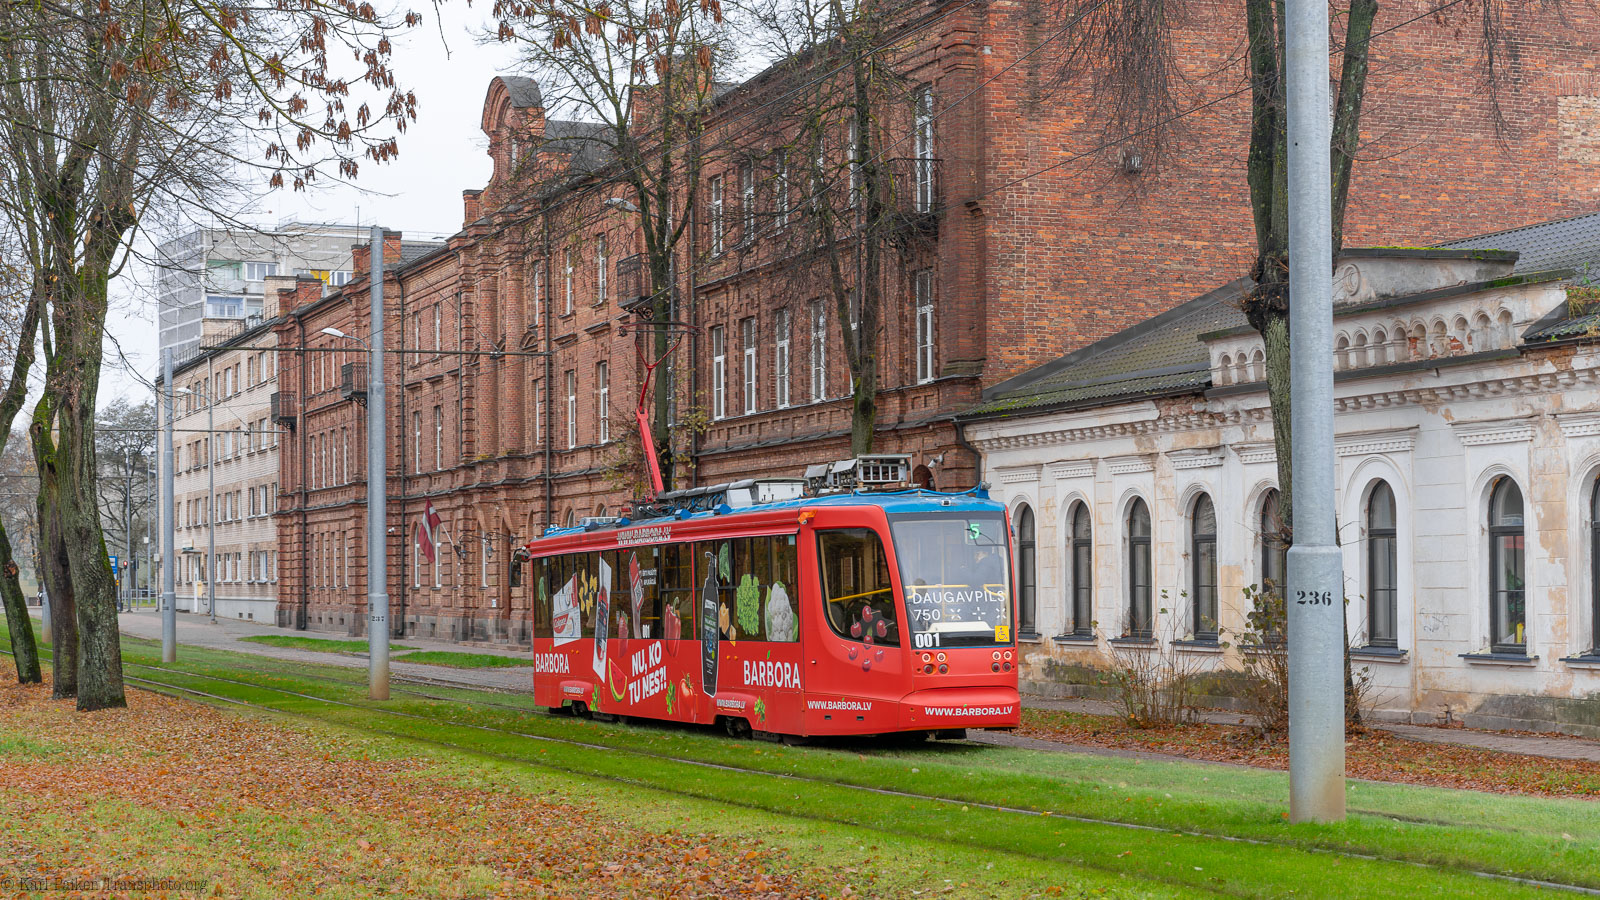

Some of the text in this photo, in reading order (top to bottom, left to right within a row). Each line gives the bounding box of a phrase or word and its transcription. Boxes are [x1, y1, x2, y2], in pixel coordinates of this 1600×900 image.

[969, 523, 980, 540] 5
[912, 590, 1006, 605] DAUGAVPILS
[1296, 590, 1332, 606] 236
[913, 608, 941, 621] 750
[915, 632, 941, 648] 001
[535, 653, 570, 674] BARBORA
[631, 640, 662, 677] NU, KO
[743, 660, 801, 689] BARBORA
[628, 665, 667, 706] TU NES?!
[807, 700, 872, 711] WWW.BARBORA.LV
[924, 706, 1013, 717] WWW.BARBORA.LV
